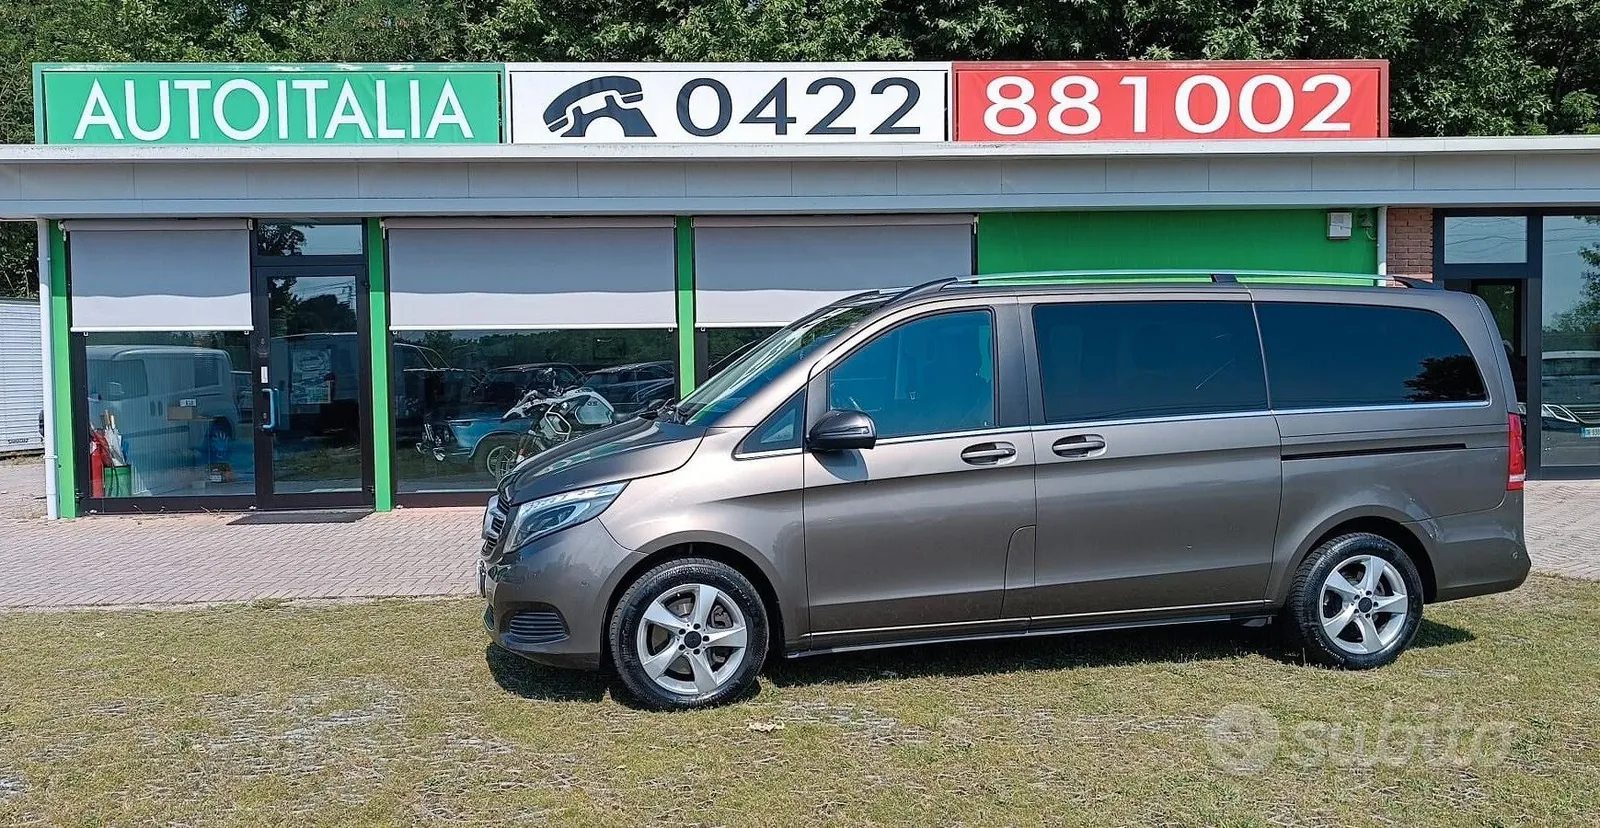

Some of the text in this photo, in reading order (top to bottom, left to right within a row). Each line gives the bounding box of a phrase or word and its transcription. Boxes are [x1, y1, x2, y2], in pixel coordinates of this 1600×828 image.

[73, 78, 474, 141] AUTOITALIA
[675, 74, 1352, 138] 0422 881002
